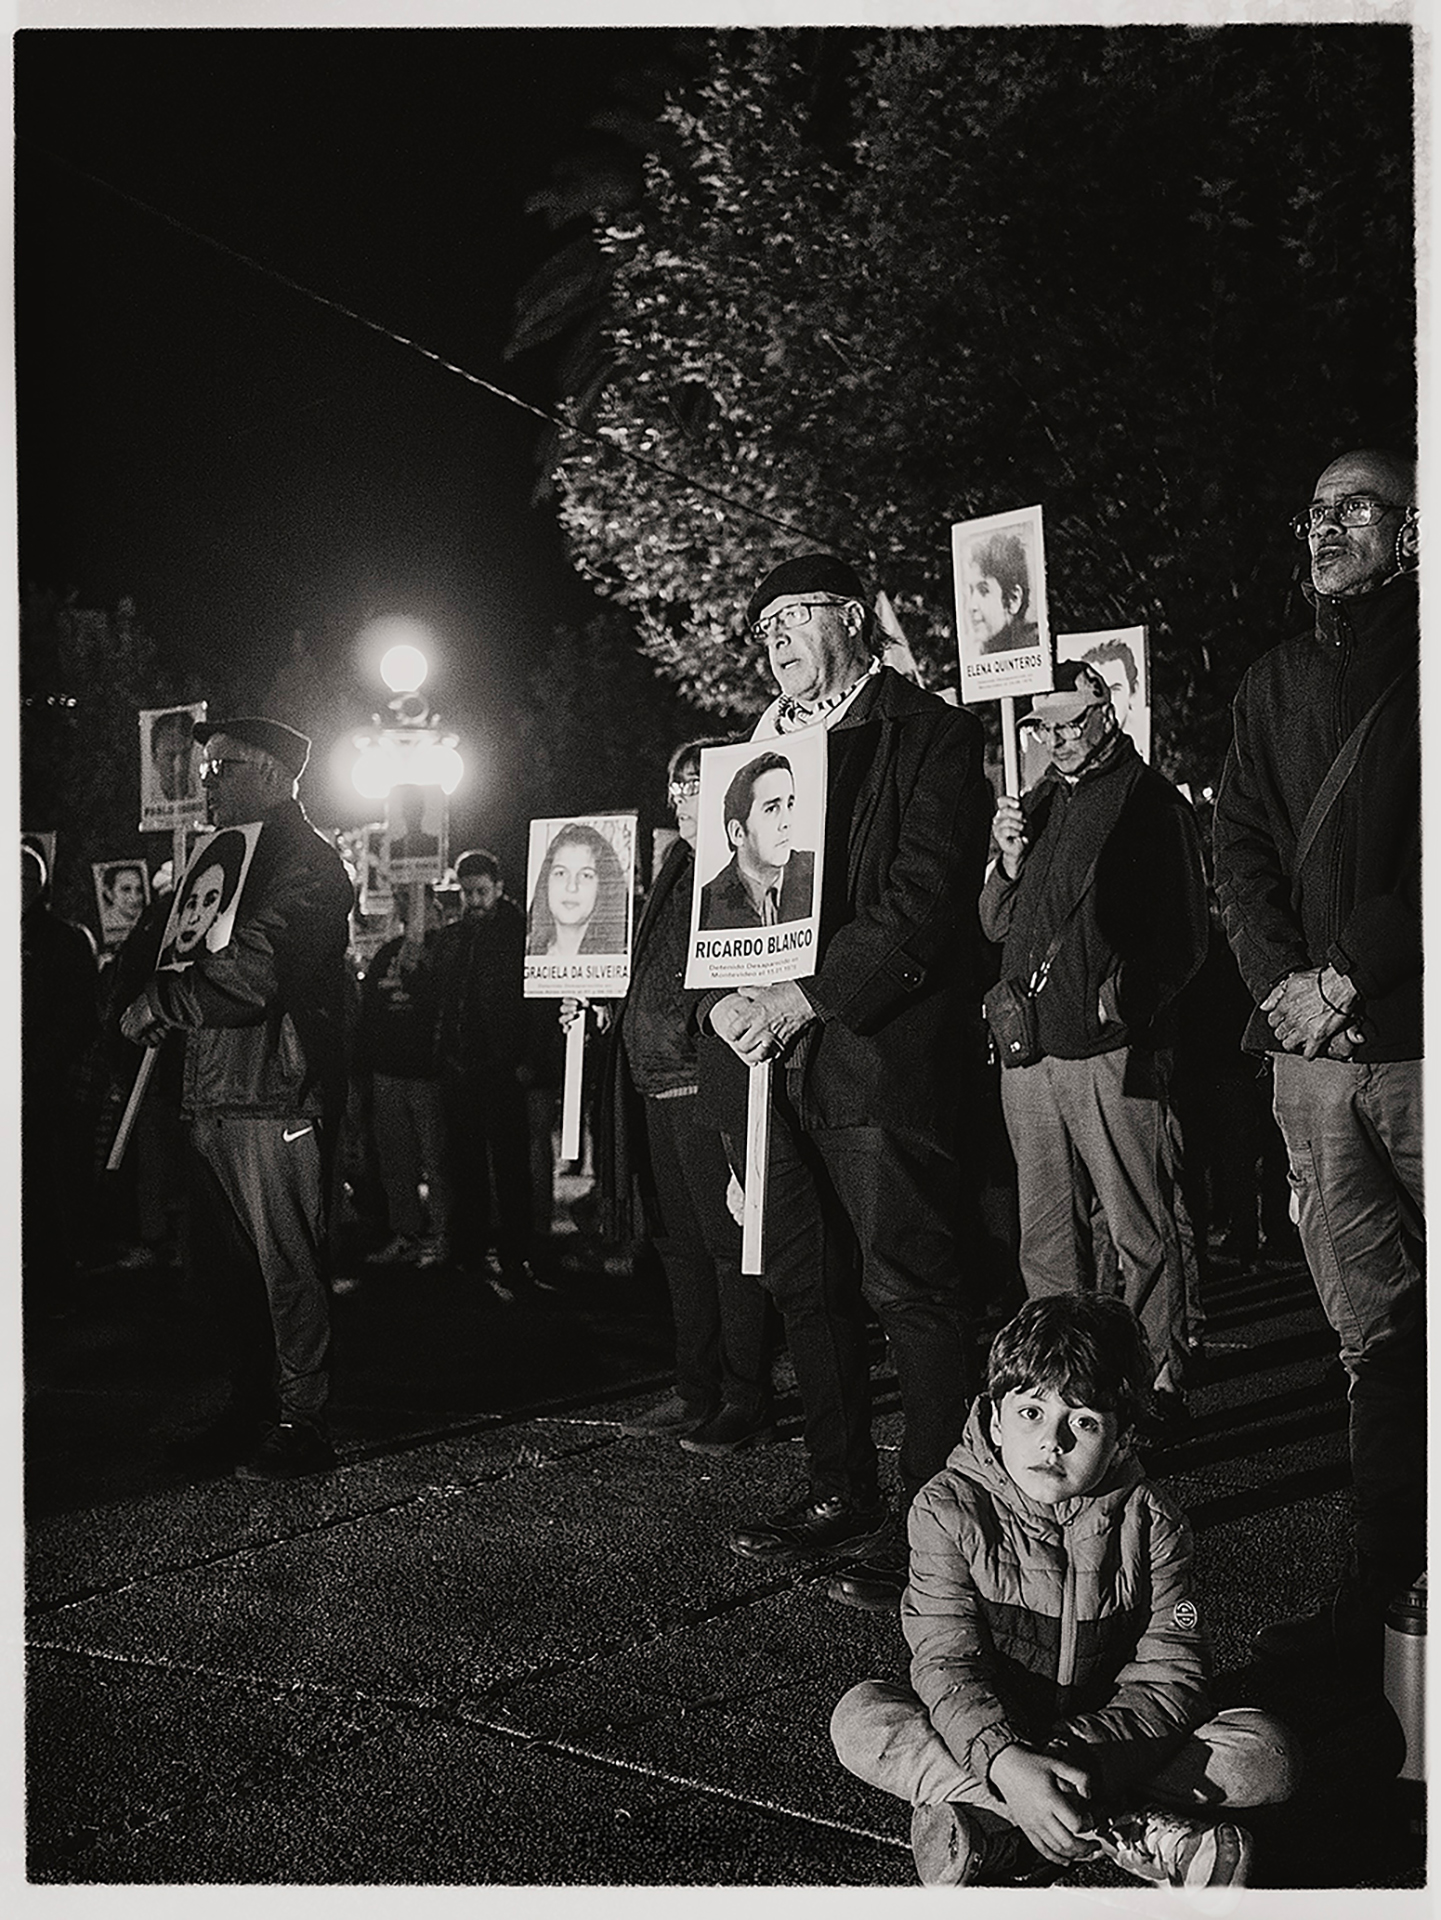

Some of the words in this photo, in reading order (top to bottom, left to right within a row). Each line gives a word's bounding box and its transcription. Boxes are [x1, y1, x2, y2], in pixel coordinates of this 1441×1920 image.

[967, 663, 992, 678] ELENA
[994, 654, 1042, 673] QUINTEROS
[695, 938, 764, 959] RICARDO
[767, 928, 813, 955] BLANCO
[524, 965, 568, 979] GRACIELA
[571, 965, 583, 979] DA
[585, 964, 629, 979] SILVEIRA
